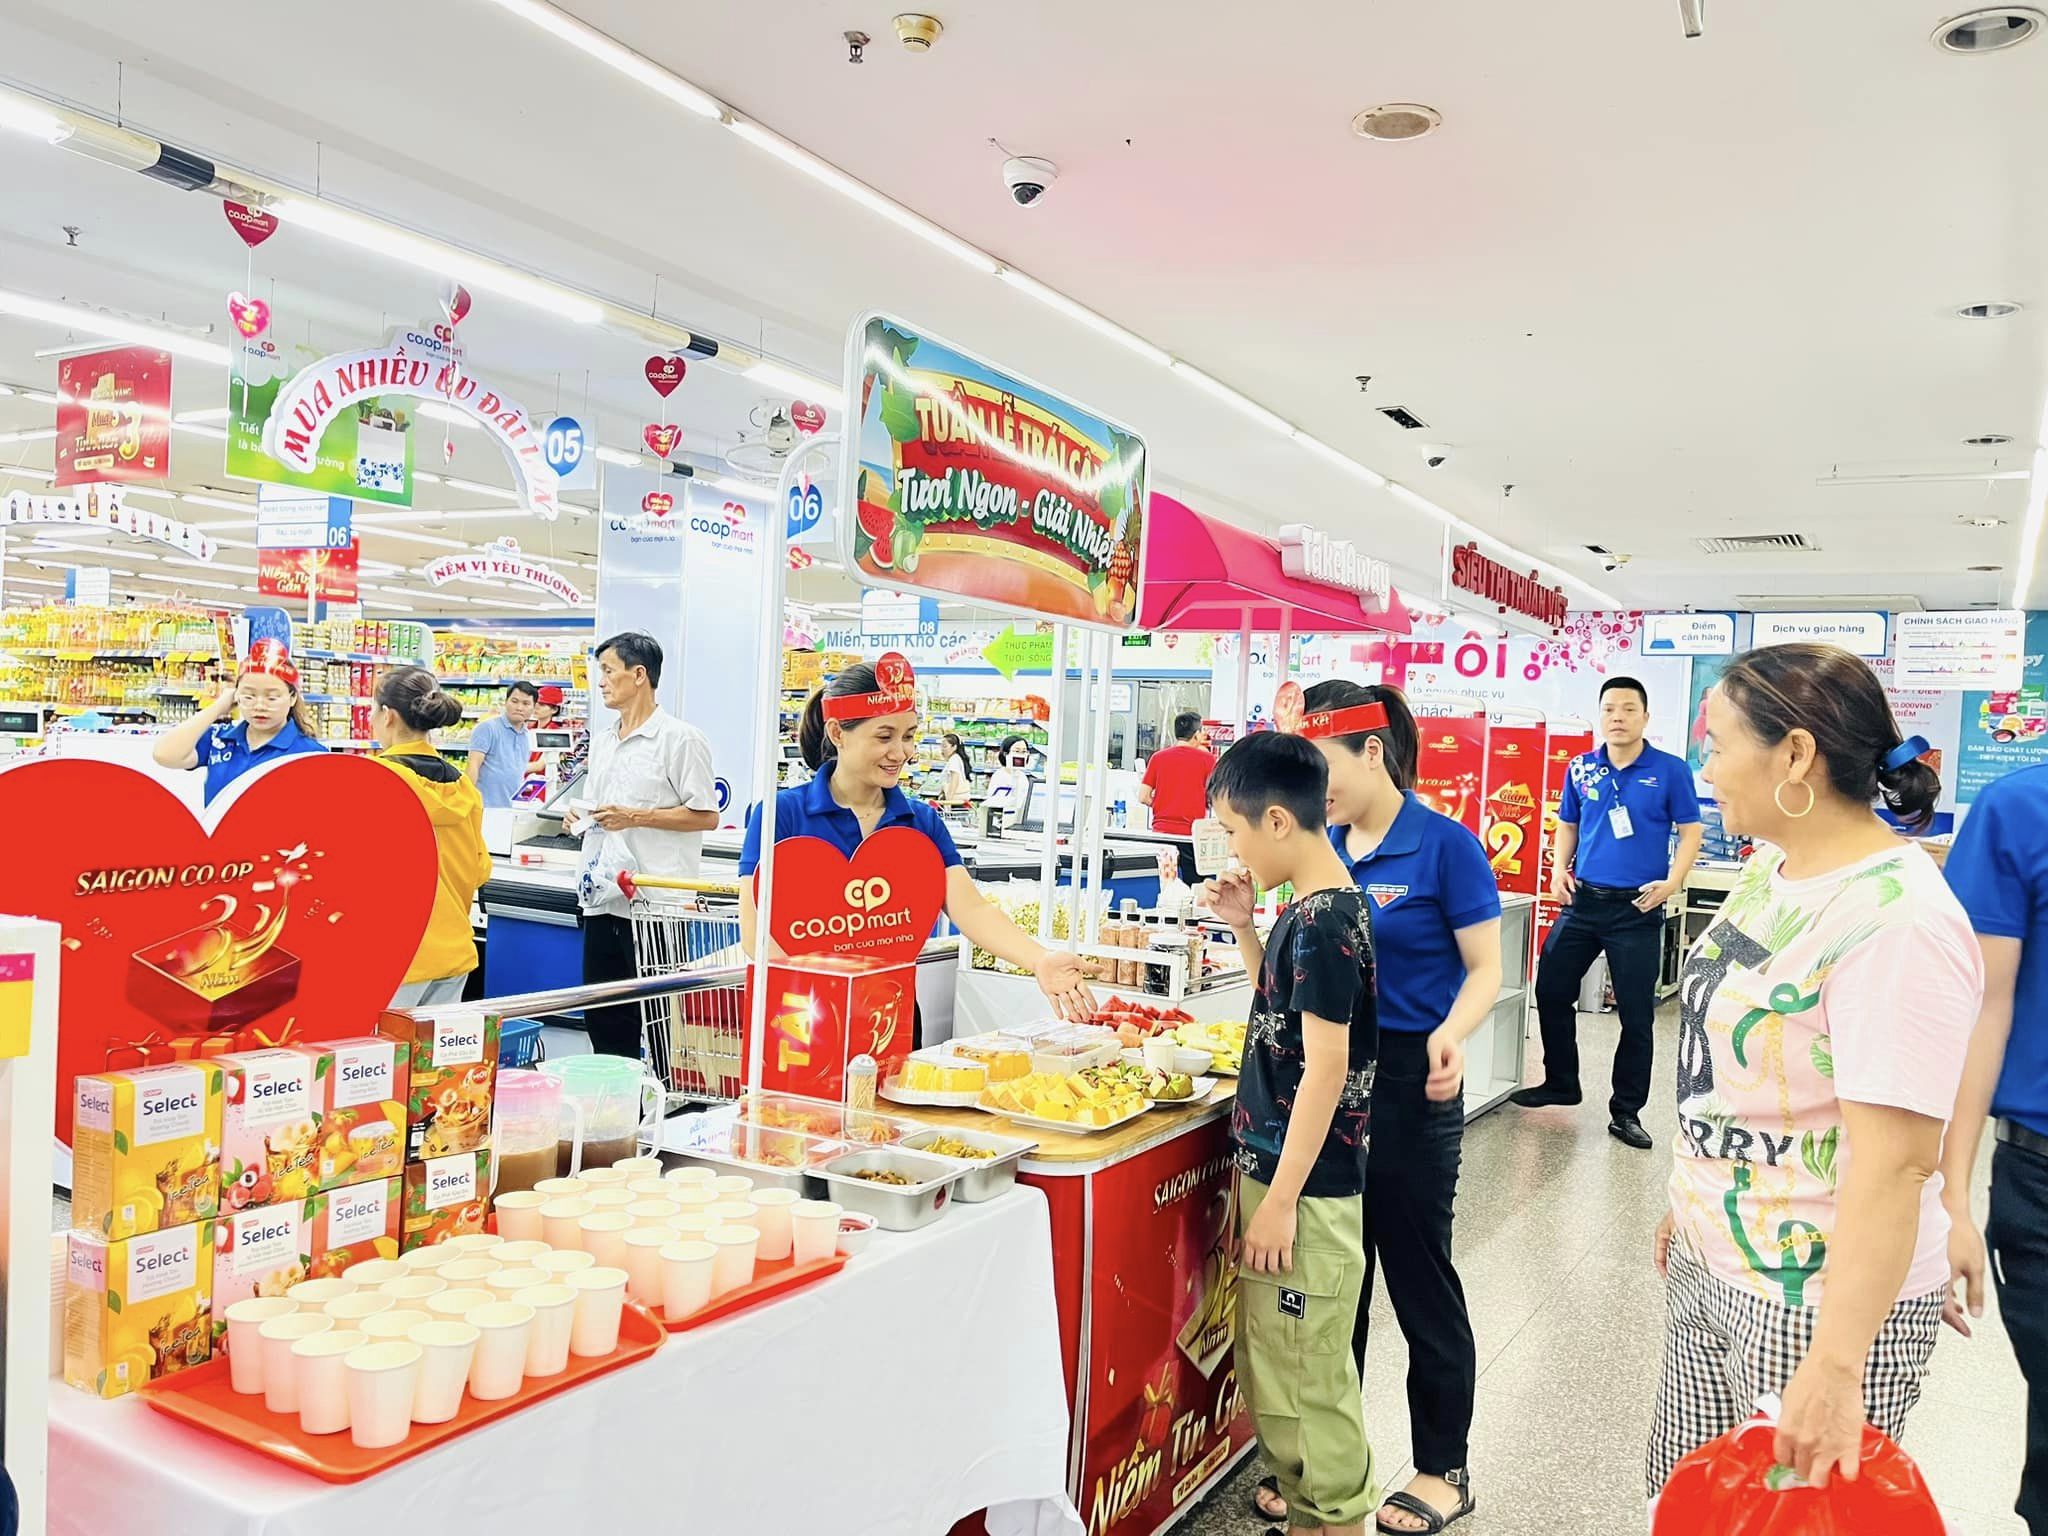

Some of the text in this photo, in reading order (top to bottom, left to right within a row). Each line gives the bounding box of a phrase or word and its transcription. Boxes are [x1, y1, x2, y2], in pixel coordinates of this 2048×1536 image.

[284, 379, 333, 464] MUA
[335, 346, 429, 398] NHIỀU
[915, 381, 984, 450] TUẦN
[986, 391, 1018, 452] LỄ
[238, 421, 260, 435] Tiết
[547, 429, 582, 465] 05
[789, 493, 819, 522] 06
[898, 466, 952, 514] Tươi
[956, 466, 1018, 520] Ngon
[1033, 488, 1073, 538] Giải
[328, 527, 347, 546] 06
[690, 517, 754, 543] co.opmart
[1452, 541, 1487, 594] SIÊU
[434, 560, 580, 603] NÊM VỊ YÊU THƯƠNG
[919, 621, 935, 634] 08
[1691, 621, 1717, 631] Điểm
[1813, 624, 1836, 635] giao
[1838, 623, 1865, 635] hàng
[1904, 614, 1934, 625] CHÍNH
[1936, 614, 1962, 625] SÁCH
[1964, 616, 1988, 625] GIAO
[826, 628, 865, 650] Miến,
[1701, 632, 1726, 643] hàng
[1488, 821, 1524, 875] 2
[75, 861, 254, 897] SAIGON CO.OP
[789, 906, 912, 940] co.opmart
[439, 1032, 479, 1048] Select
[342, 1062, 387, 1081] Select
[252, 1077, 303, 1098] Select
[80, 1093, 110, 1114] Select
[143, 1092, 198, 1116] Select
[431, 1172, 471, 1191] Select
[1153, 1167, 1200, 1214] SAIGON
[335, 1199, 381, 1222] Select
[240, 1221, 291, 1246] Select
[71, 1250, 103, 1273] Select
[135, 1247, 190, 1273] Select
